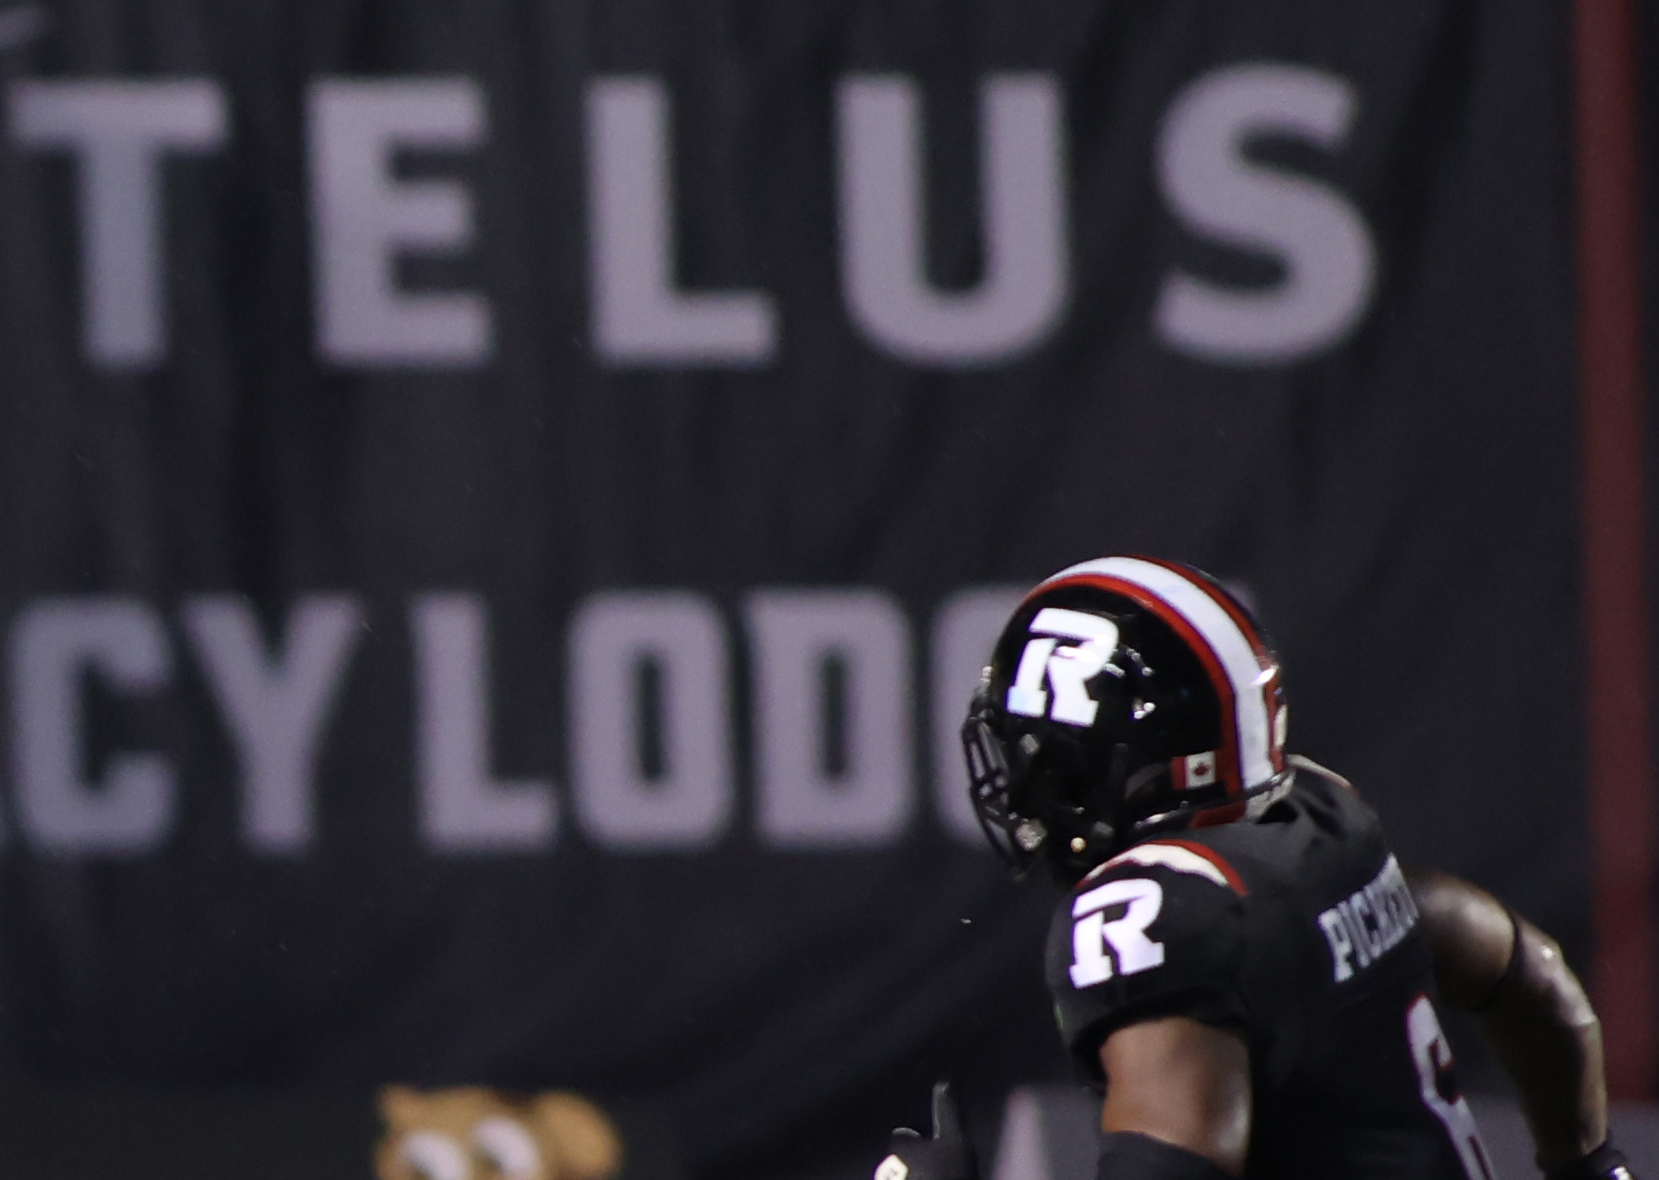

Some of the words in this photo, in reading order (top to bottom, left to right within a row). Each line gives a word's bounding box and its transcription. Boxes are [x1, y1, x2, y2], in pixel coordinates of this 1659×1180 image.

[6, 62, 1379, 372] TELUS
[411, 587, 1041, 855] LOD
[1006, 606, 1120, 728] R
[1069, 877, 1165, 989] R
